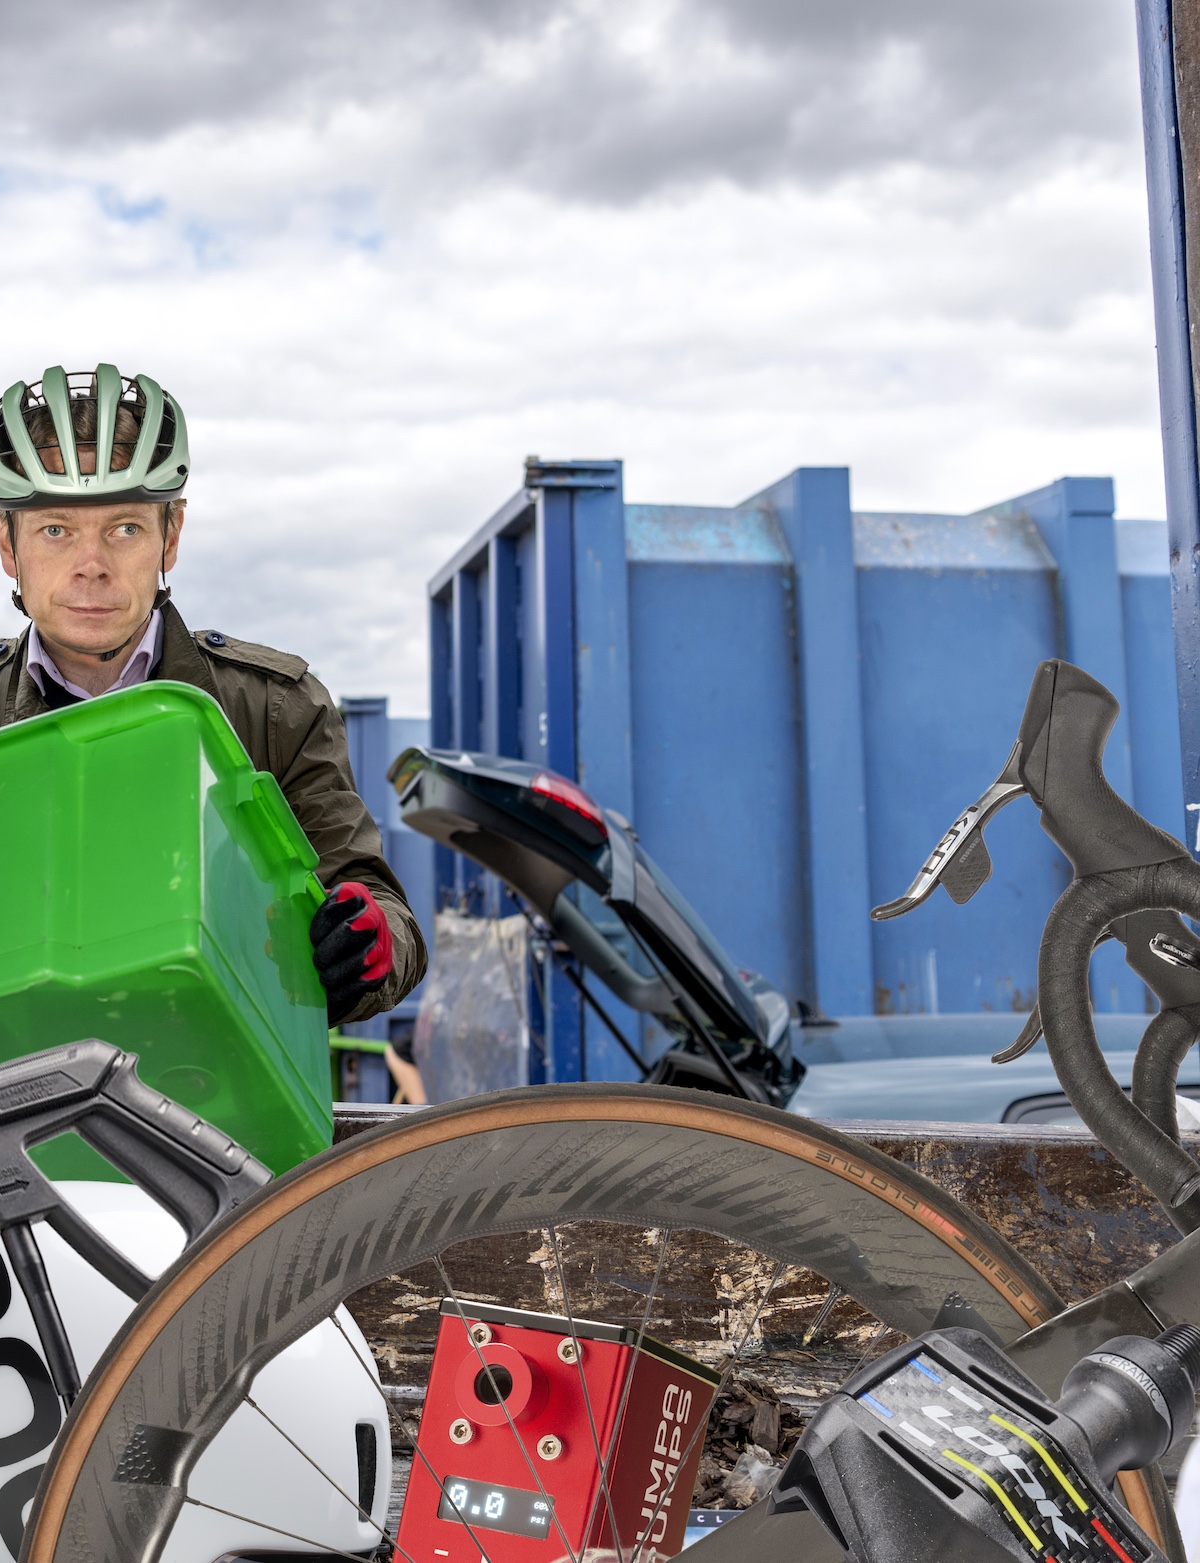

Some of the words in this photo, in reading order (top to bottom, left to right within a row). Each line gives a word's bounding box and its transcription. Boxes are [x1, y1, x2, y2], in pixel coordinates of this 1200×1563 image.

[1099, 1354, 1161, 1402] CERAMIC
[921, 1405, 1089, 1550] LOOK
[448, 1484, 505, 1519] 0.0
[530, 1516, 545, 1525] psi
